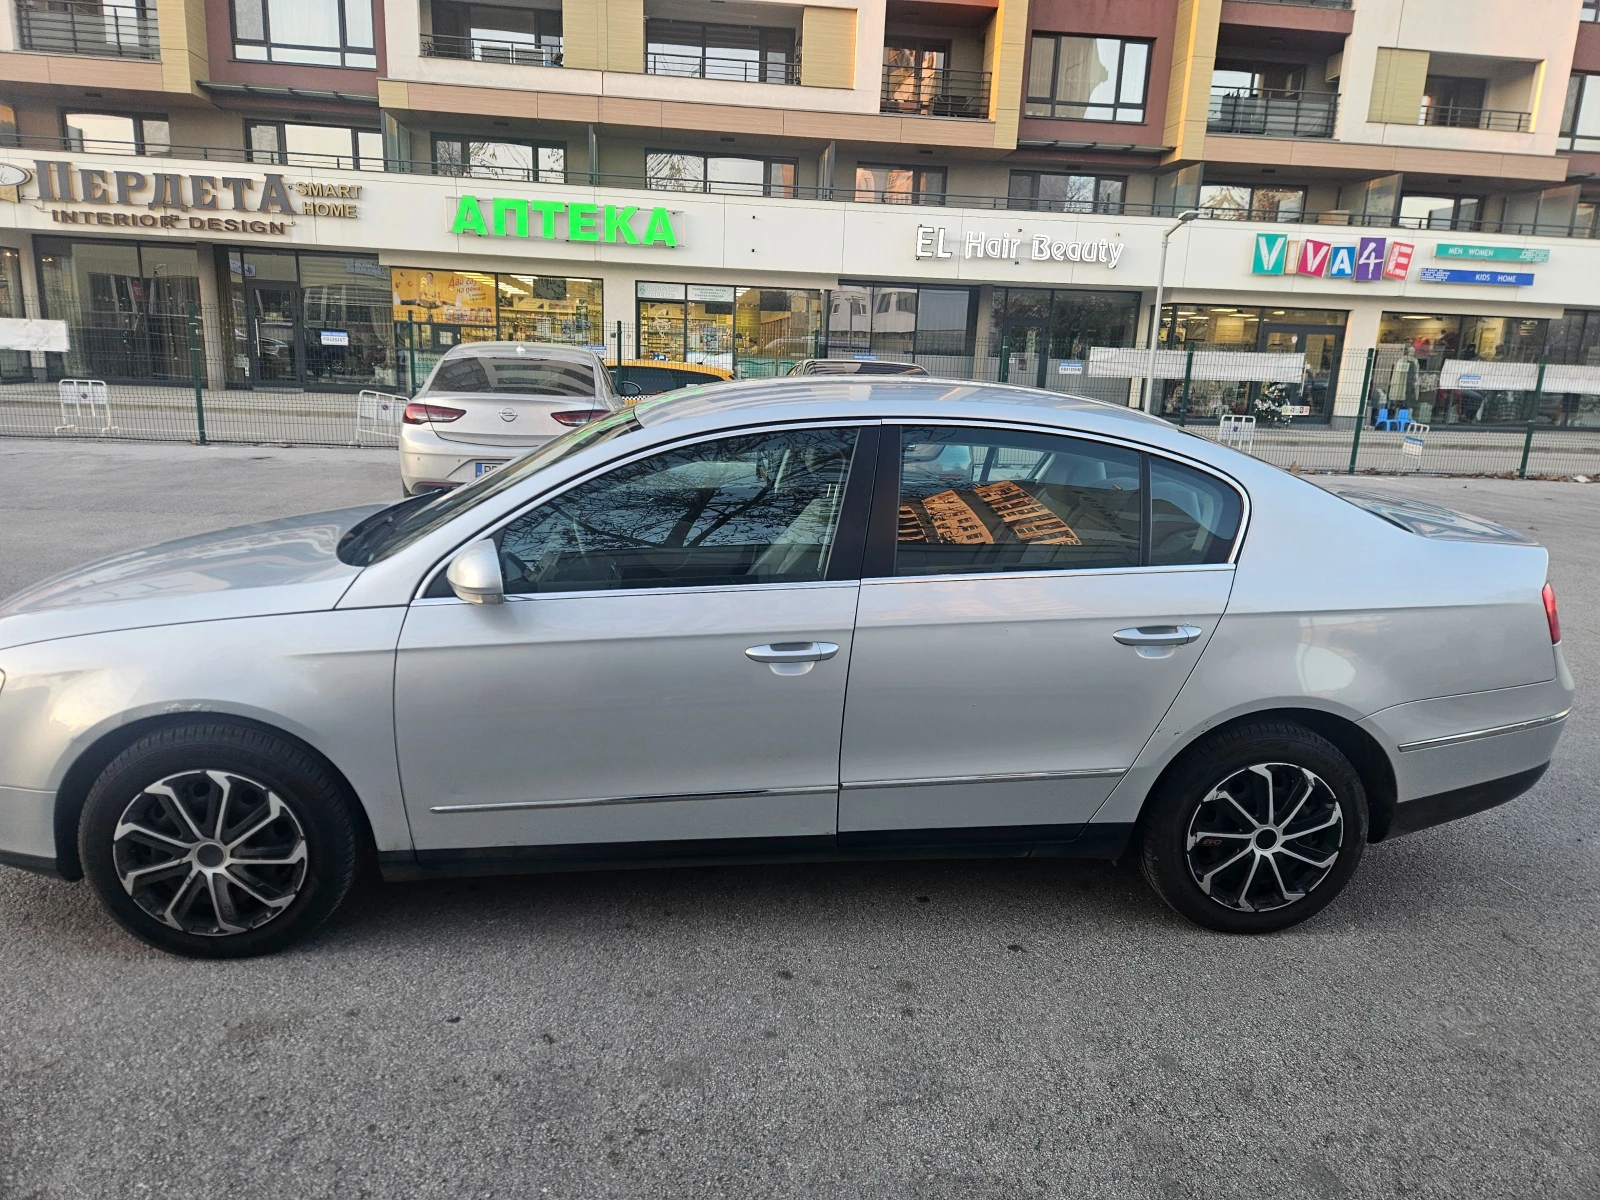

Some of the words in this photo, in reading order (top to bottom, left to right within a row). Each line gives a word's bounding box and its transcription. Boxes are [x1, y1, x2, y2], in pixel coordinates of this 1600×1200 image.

[296, 181, 362, 199] SMART
[302, 201, 357, 218] HOME
[452, 194, 677, 247] АПТЕКА
[51, 209, 177, 229] INTERIOR
[189, 216, 286, 235] DESIGN
[916, 226, 952, 259] EL
[965, 231, 1020, 260] Hair
[1031, 234, 1124, 268] Beauty
[1257, 236, 1412, 279] VIVA4E
[1448, 247, 1463, 255] MEN
[1468, 248, 1494, 256] WOMEN
[1475, 273, 1491, 281] KIDS
